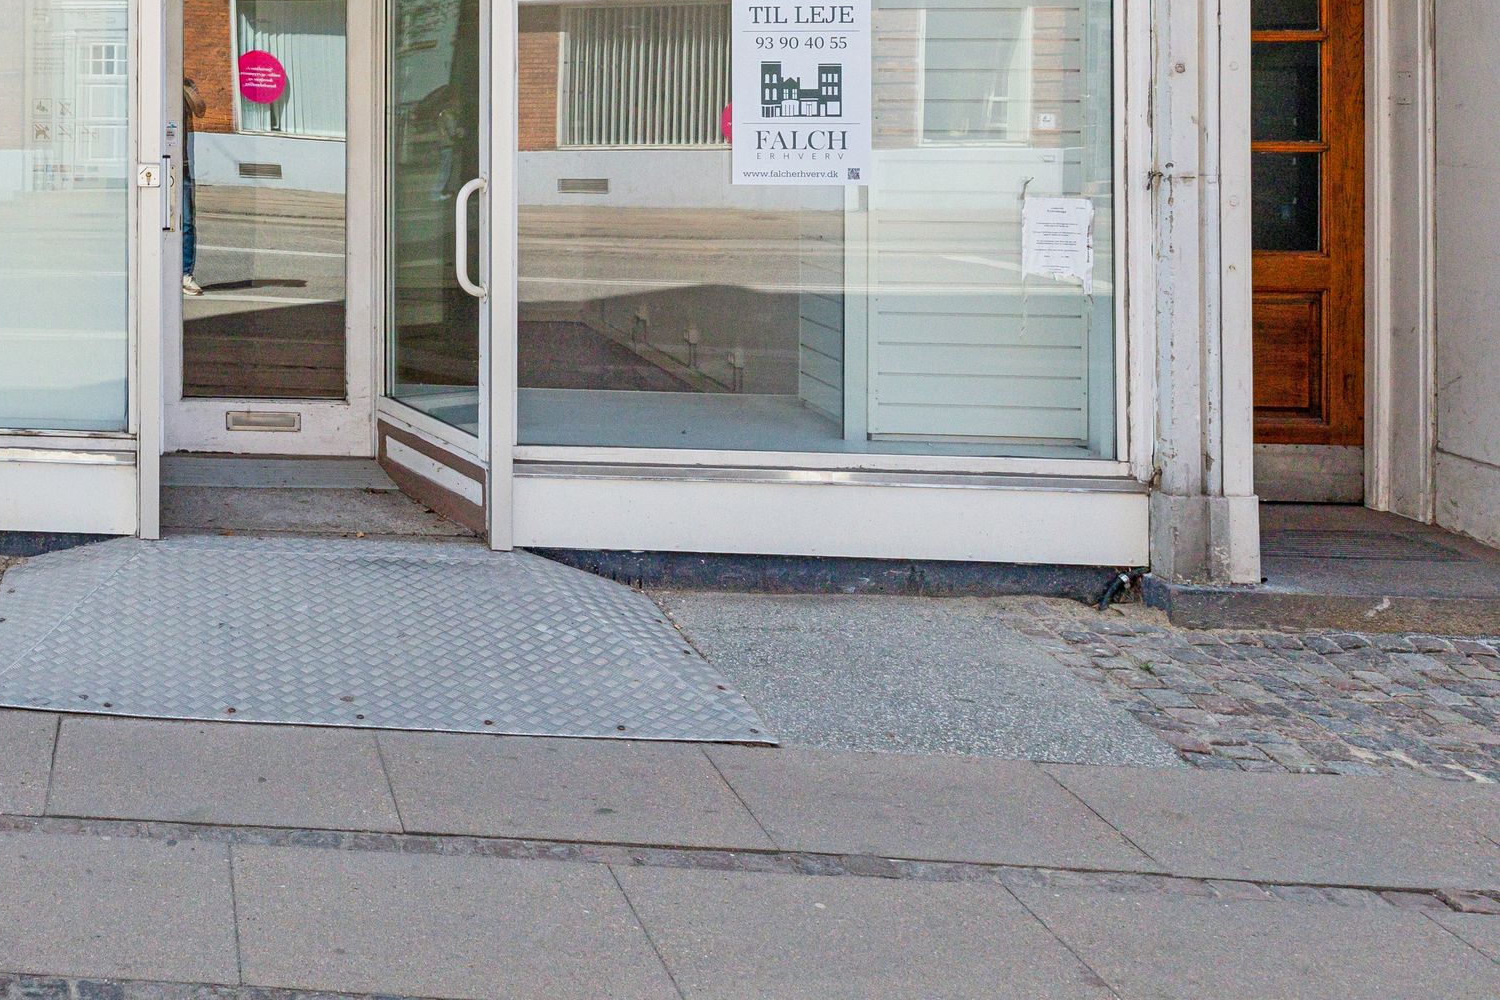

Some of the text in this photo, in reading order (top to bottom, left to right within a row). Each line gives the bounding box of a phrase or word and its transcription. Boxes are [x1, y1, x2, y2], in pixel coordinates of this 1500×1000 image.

[748, 6, 854, 24] TIL LEJE
[755, 36, 848, 50] 93 90 40 55
[755, 130, 848, 151] FALCH
[756, 152, 844, 160] ERHVERV
[742, 169, 838, 179] www.falcherhverv.dk
